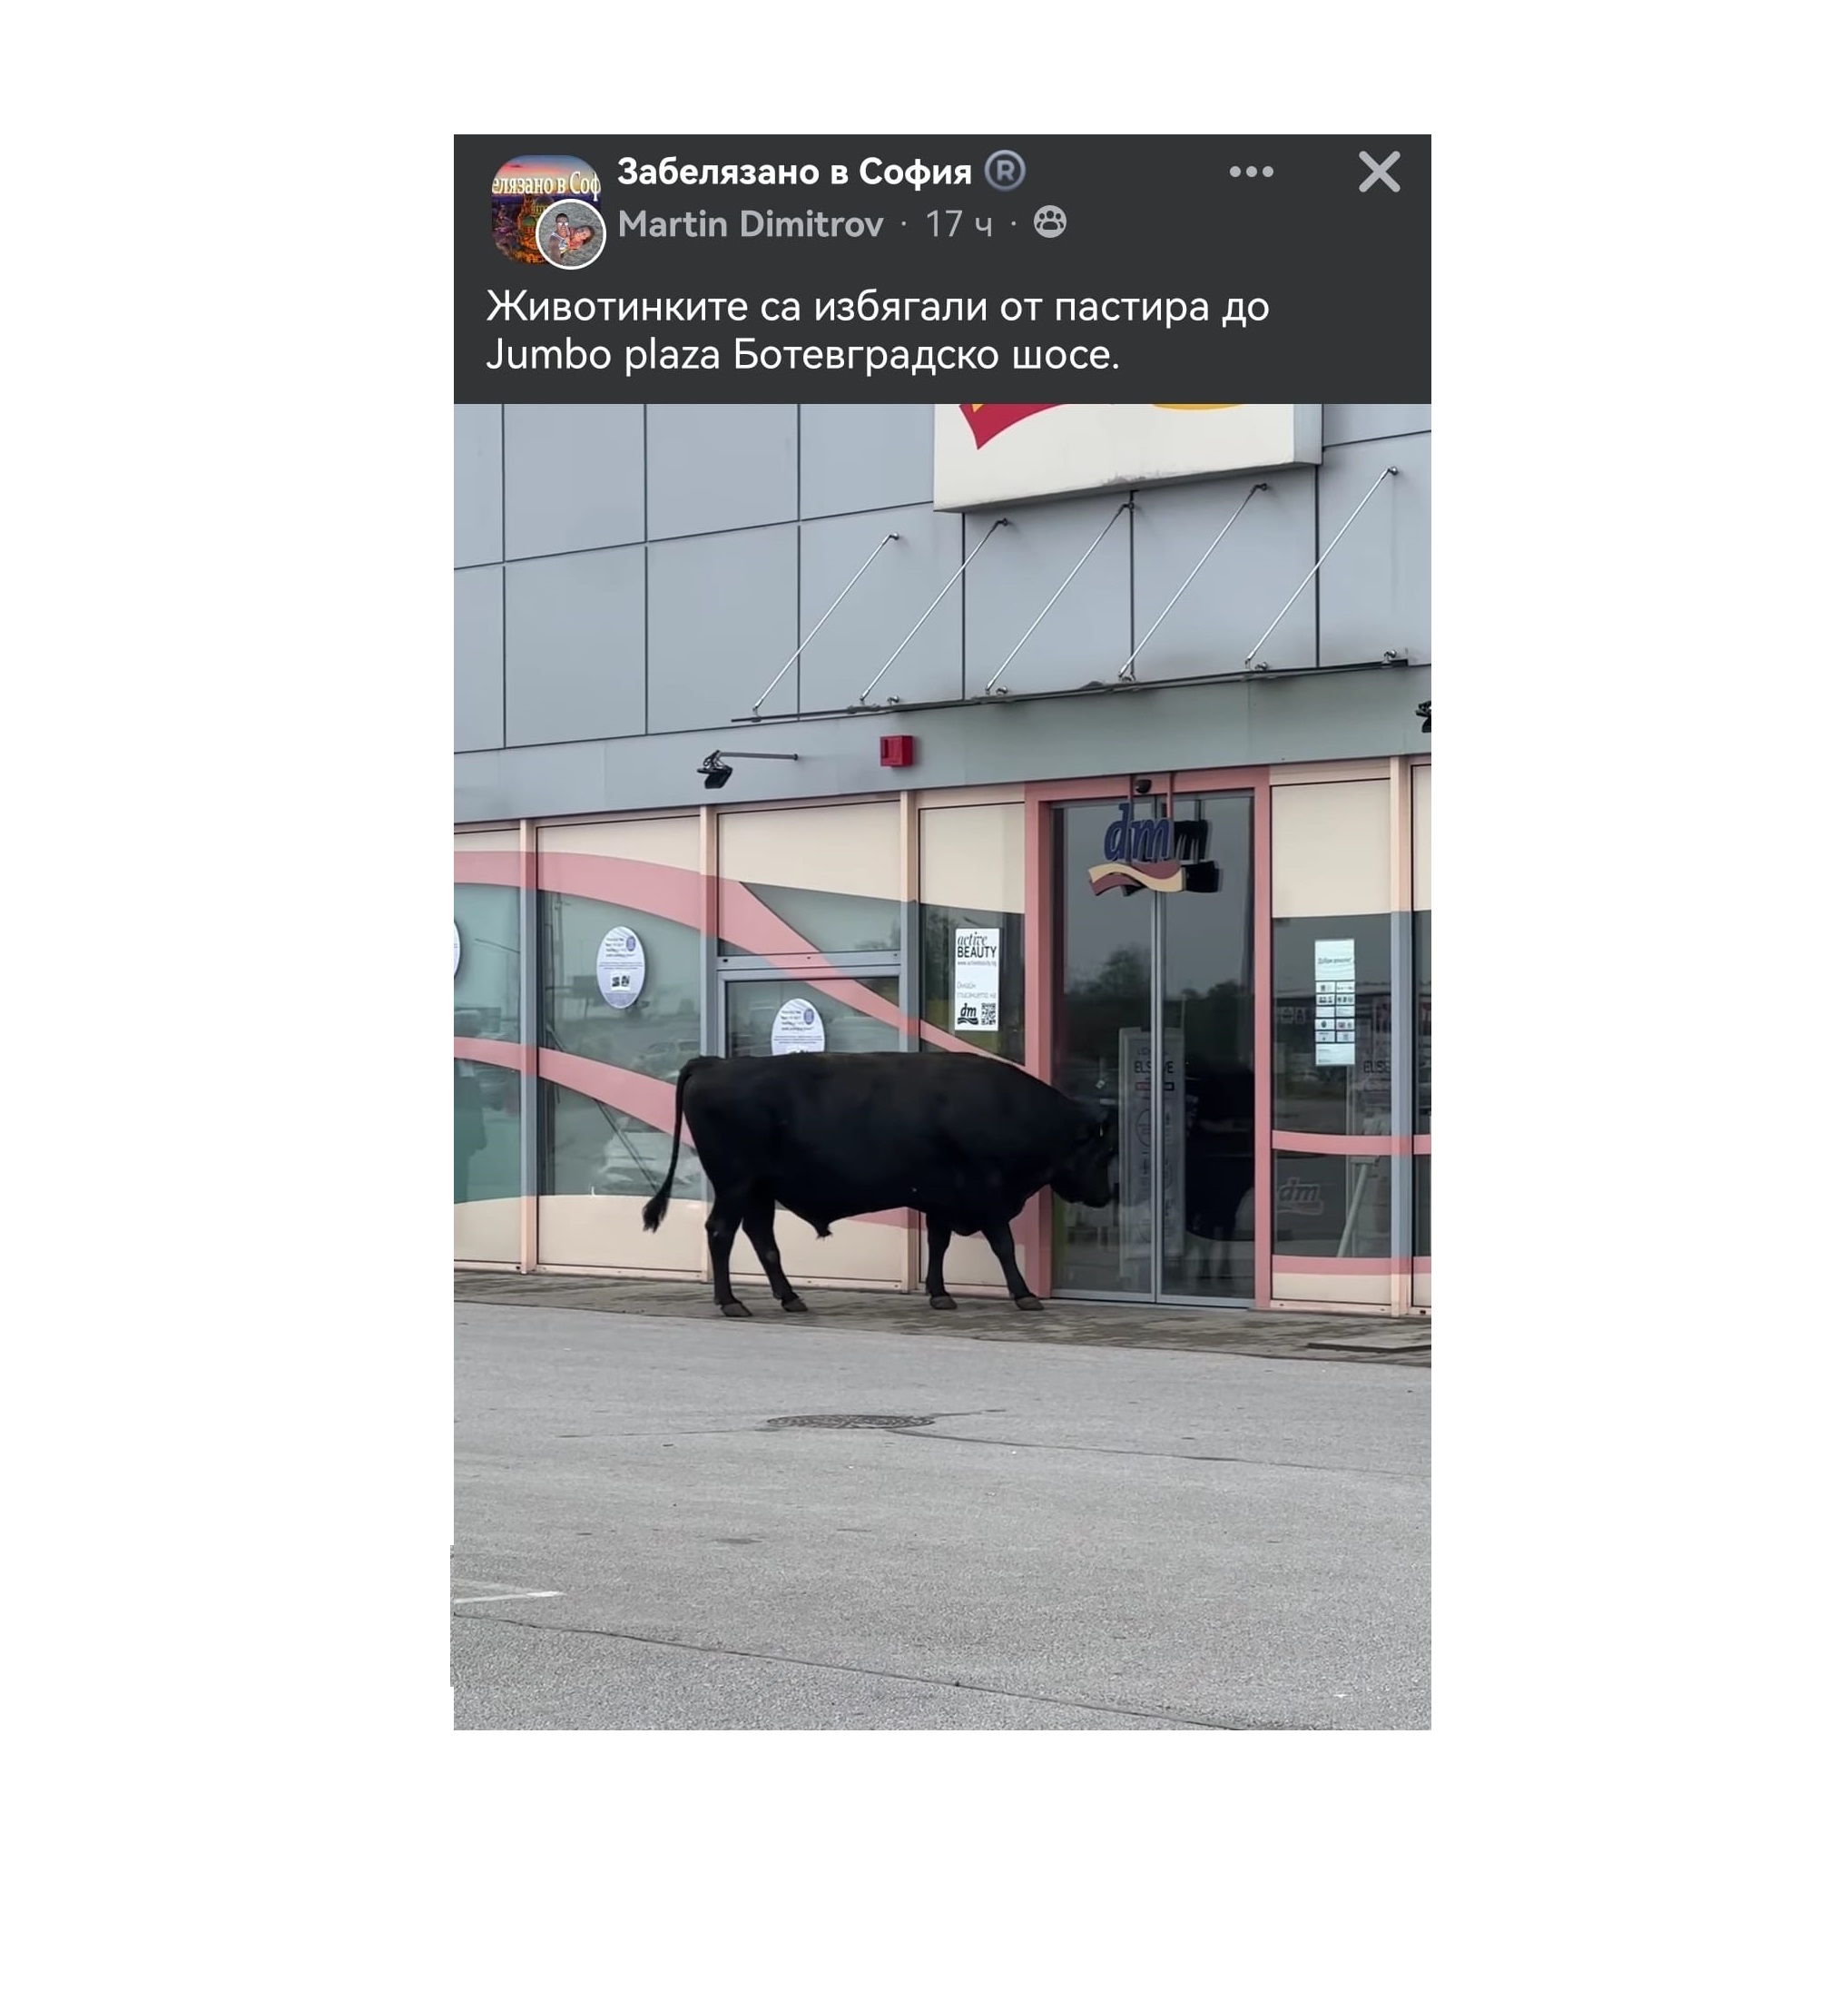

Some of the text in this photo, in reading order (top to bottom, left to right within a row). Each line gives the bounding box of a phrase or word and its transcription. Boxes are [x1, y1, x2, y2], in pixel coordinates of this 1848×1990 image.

[1104, 803, 1174, 862] dm
[957, 931, 988, 946] active
[957, 945, 998, 959] BEAUTY
[959, 1002, 977, 1017] dm
[1134, 1059, 1174, 1074] ELSVE
